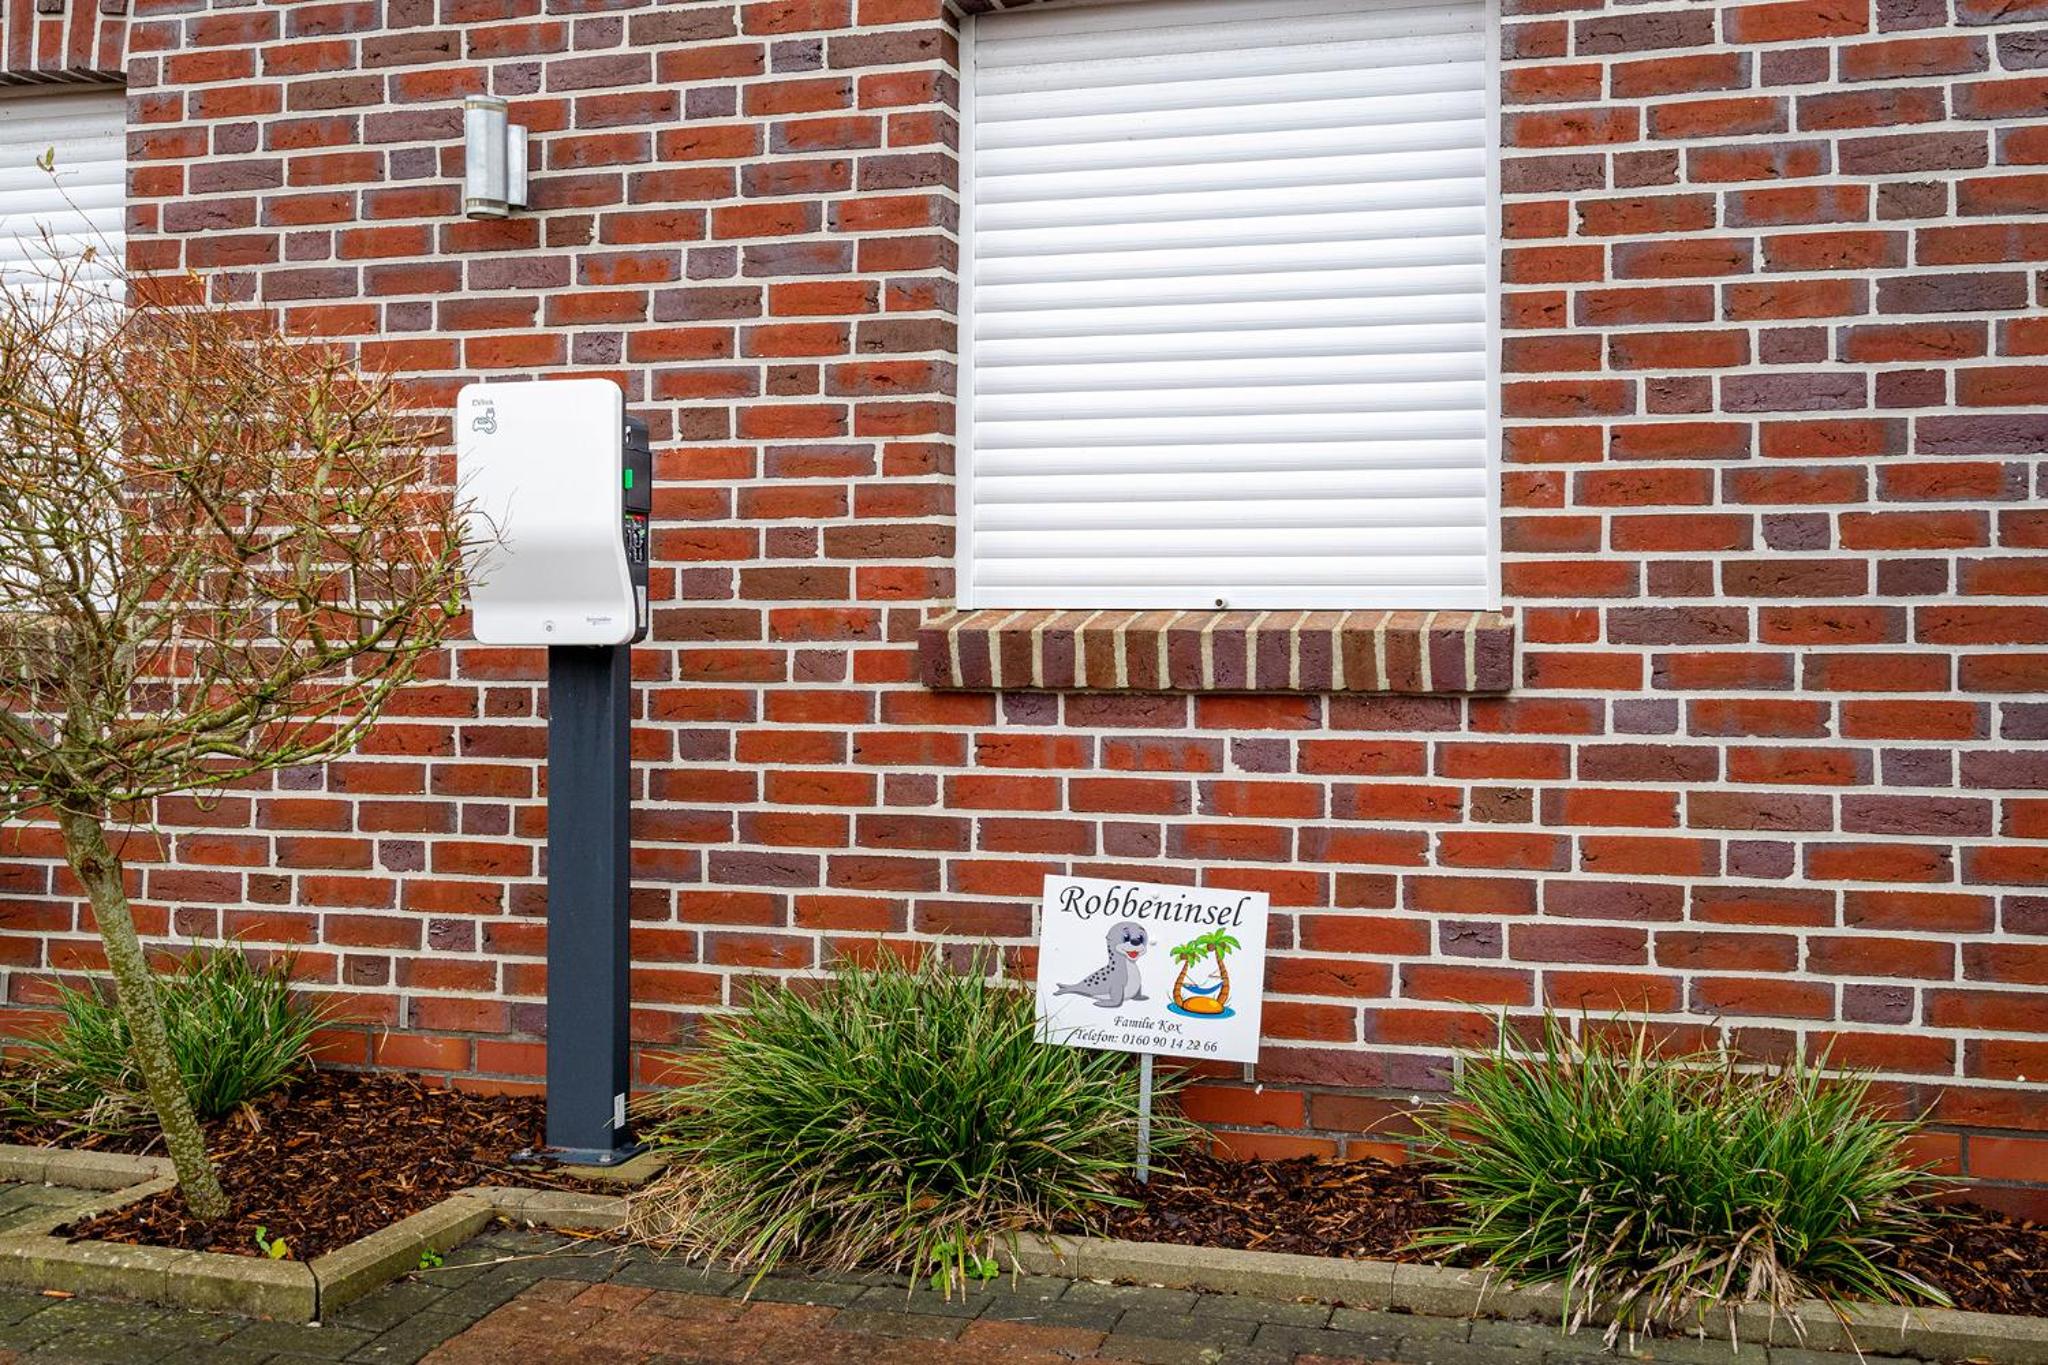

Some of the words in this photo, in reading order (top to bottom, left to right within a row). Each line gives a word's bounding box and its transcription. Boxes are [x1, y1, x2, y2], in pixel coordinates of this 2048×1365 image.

[1059, 885, 1251, 927] Robbeninsel
[1113, 1015, 1154, 1031] Familie
[1157, 1019, 1183, 1035] Kox
[1075, 1028, 1119, 1045] Telefon:
[1122, 1033, 1150, 1047] 0160
[1152, 1035, 1167, 1048] 90
[1170, 1037, 1184, 1049] 14
[1186, 1039, 1201, 1050] 22
[1203, 1040, 1218, 1052] 66
